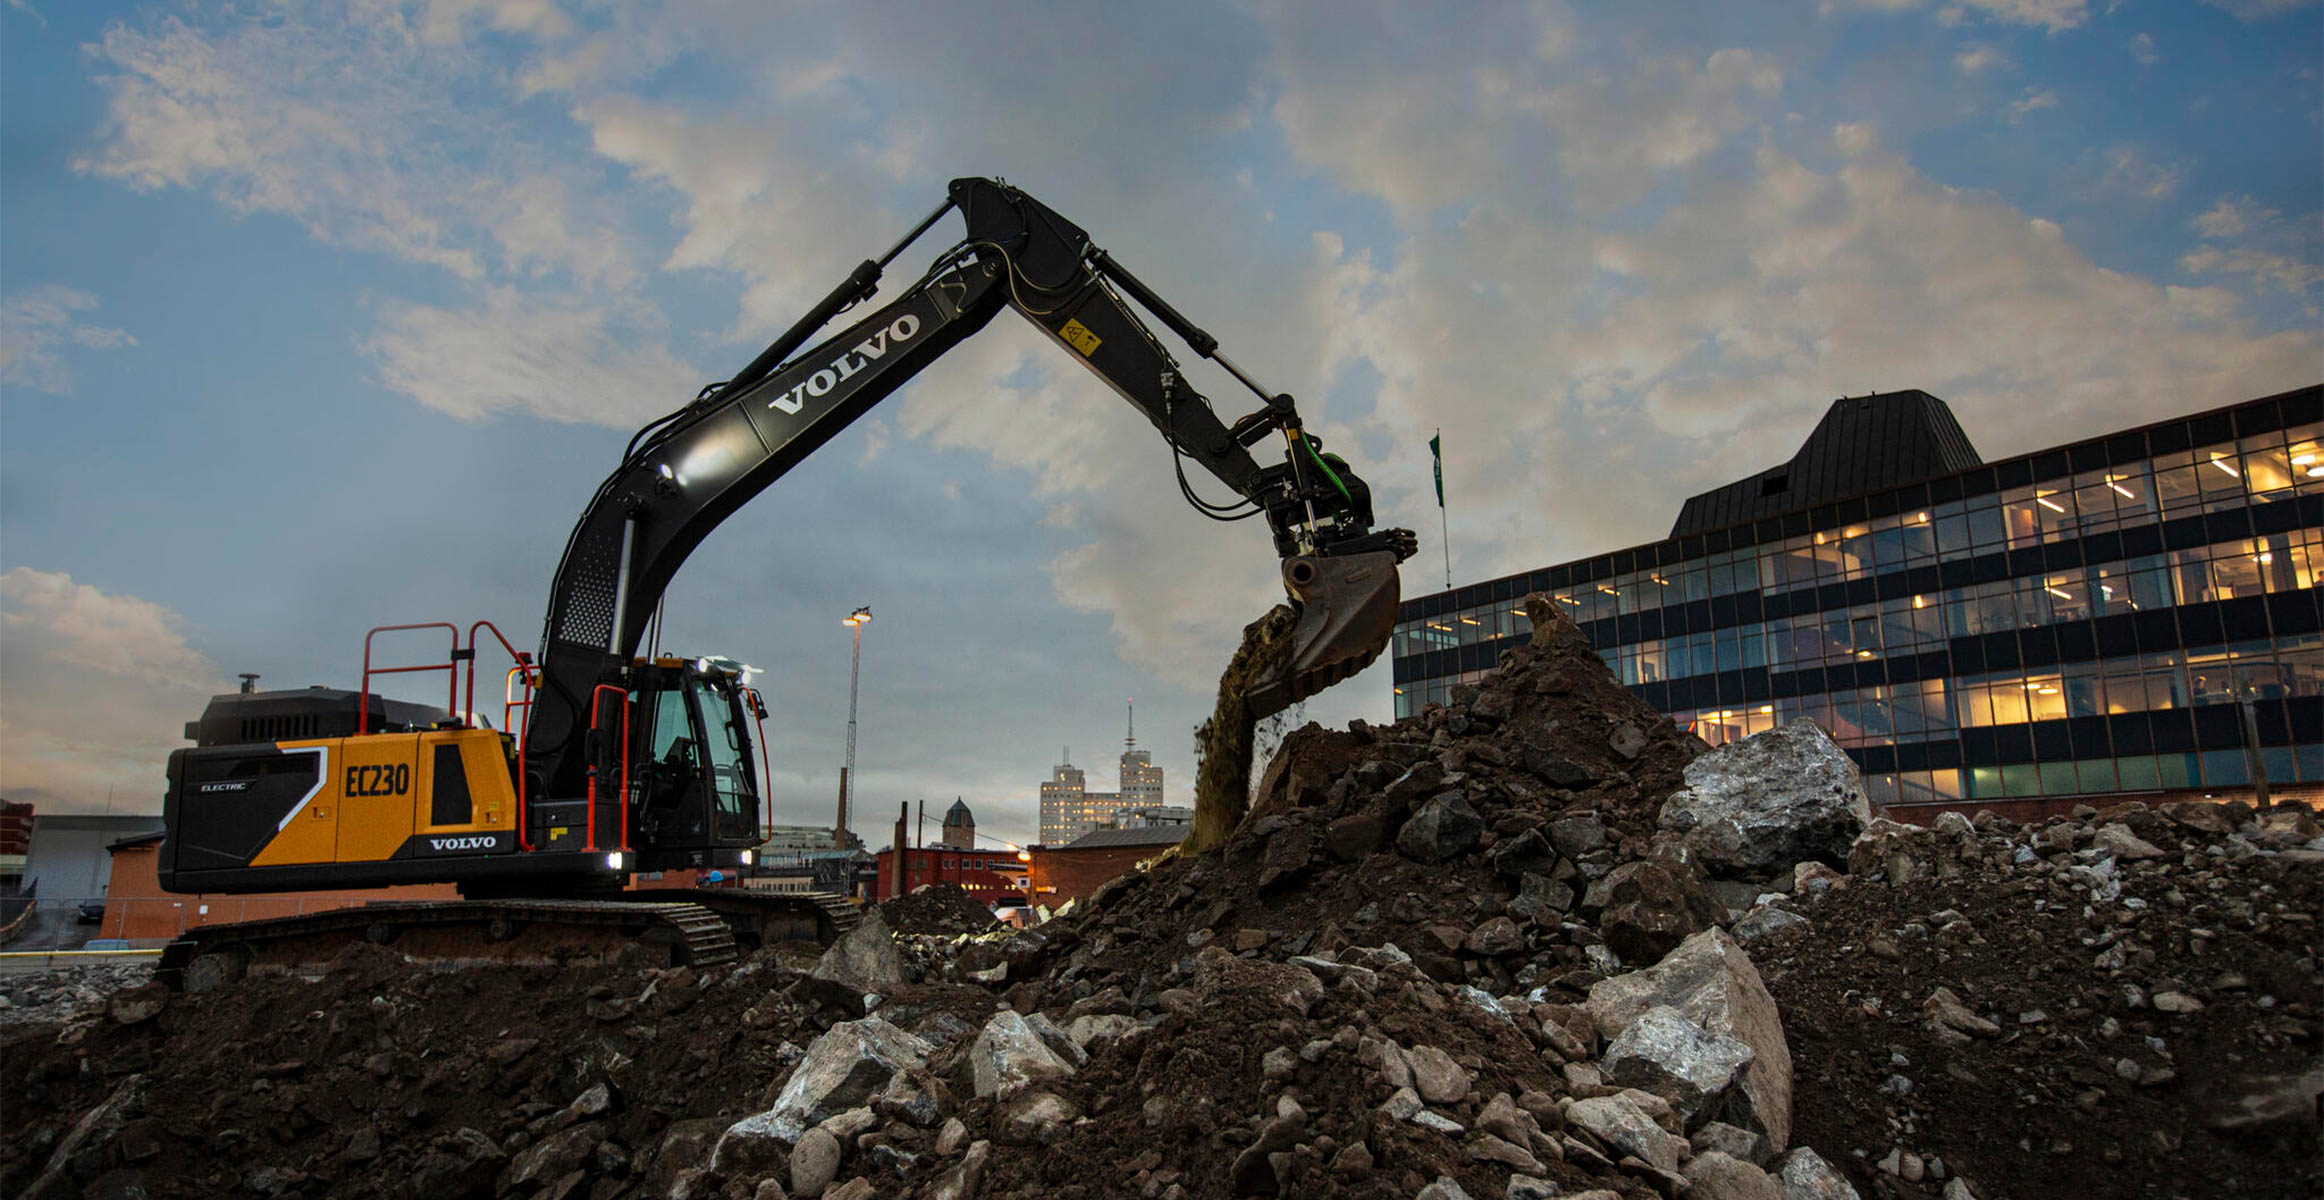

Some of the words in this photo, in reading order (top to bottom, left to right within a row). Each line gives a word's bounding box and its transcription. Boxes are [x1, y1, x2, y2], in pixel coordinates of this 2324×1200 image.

[768, 314, 920, 415] VOLVO
[201, 782, 246, 792] ELECTRIC
[345, 763, 409, 798] EC230
[430, 836, 497, 851] VOLVO
